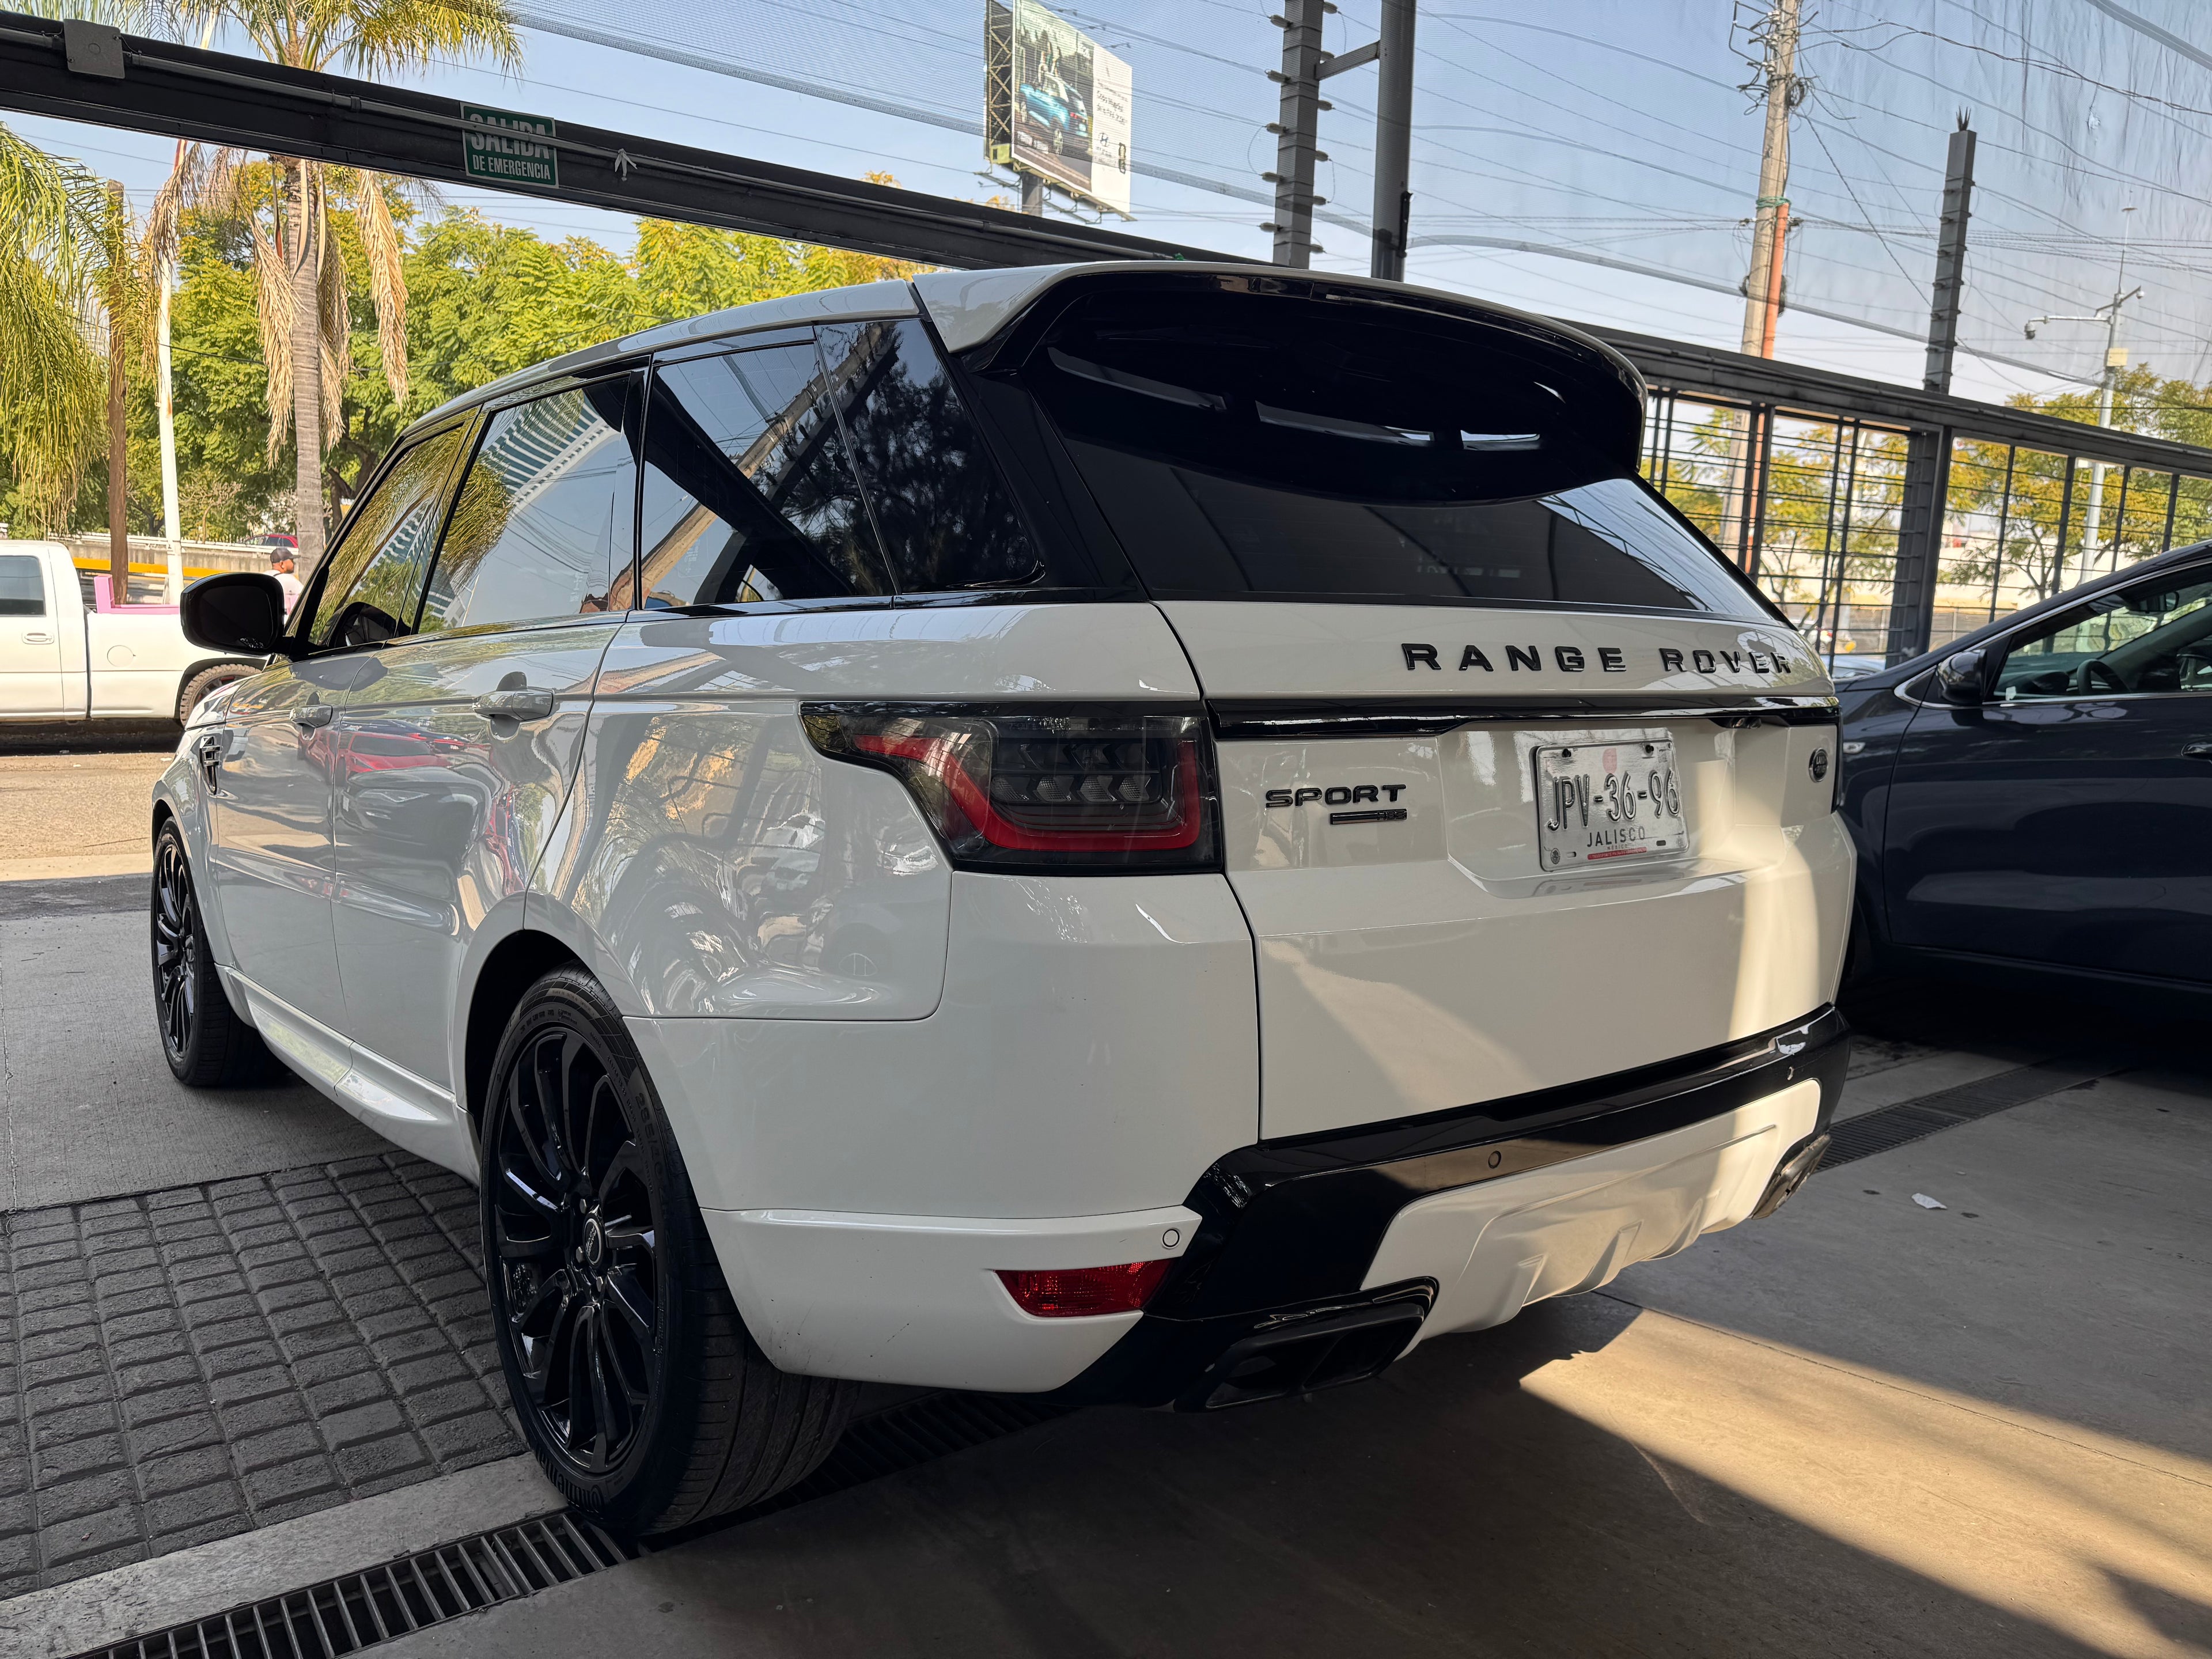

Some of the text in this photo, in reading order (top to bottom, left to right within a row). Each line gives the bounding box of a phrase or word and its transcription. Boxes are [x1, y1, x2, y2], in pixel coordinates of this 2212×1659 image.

[469, 113, 550, 159] SALIDA
[472, 154, 551, 180] DE EMERGENCIA
[1401, 643, 1791, 673] RANGE ROVER
[1266, 784, 1407, 808] SPORT
[1548, 767, 1680, 831] JPV-36-96
[1587, 826, 1645, 847] JALISCO
